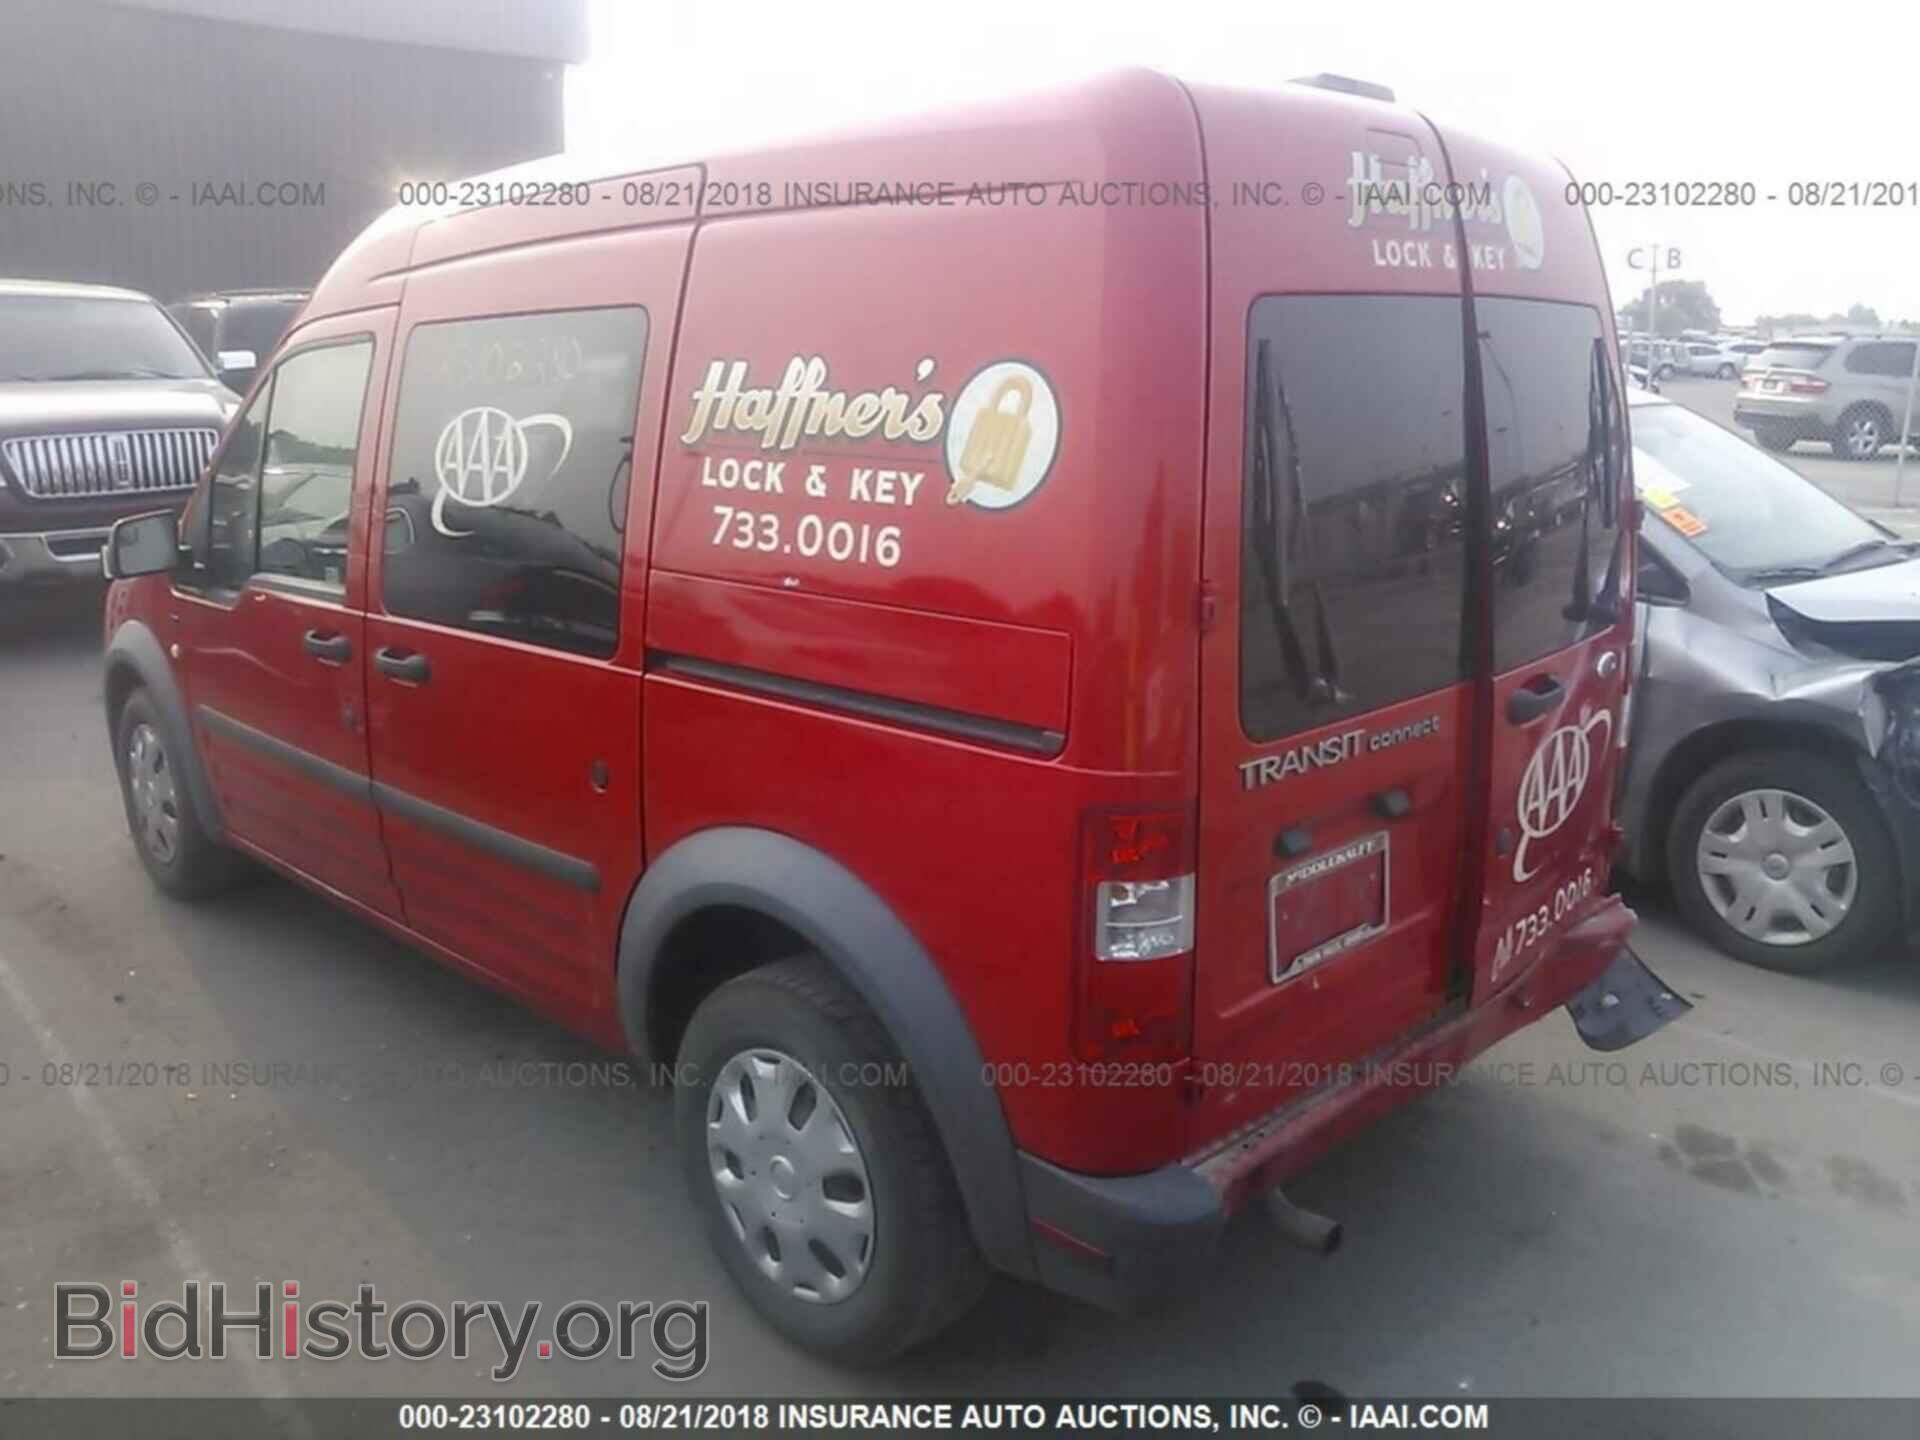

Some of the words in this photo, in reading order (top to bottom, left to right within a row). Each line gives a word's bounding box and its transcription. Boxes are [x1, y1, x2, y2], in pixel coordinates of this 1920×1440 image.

[1372, 239, 1432, 267] LOCK
[1472, 244, 1504, 270] KEY
[1627, 248, 1644, 270] C
[1667, 247, 1682, 270] B
[681, 354, 945, 453] Haffner's
[440, 409, 519, 505] AAA
[701, 456, 785, 494] LOCK
[805, 464, 827, 497] &
[849, 467, 925, 506] KEY
[711, 505, 902, 568] 733.0016
[1239, 729, 1366, 790] TRANSIT
[1369, 715, 1440, 751] connect
[1522, 728, 1585, 835] AAA
[1515, 867, 1593, 956] 733.0016
